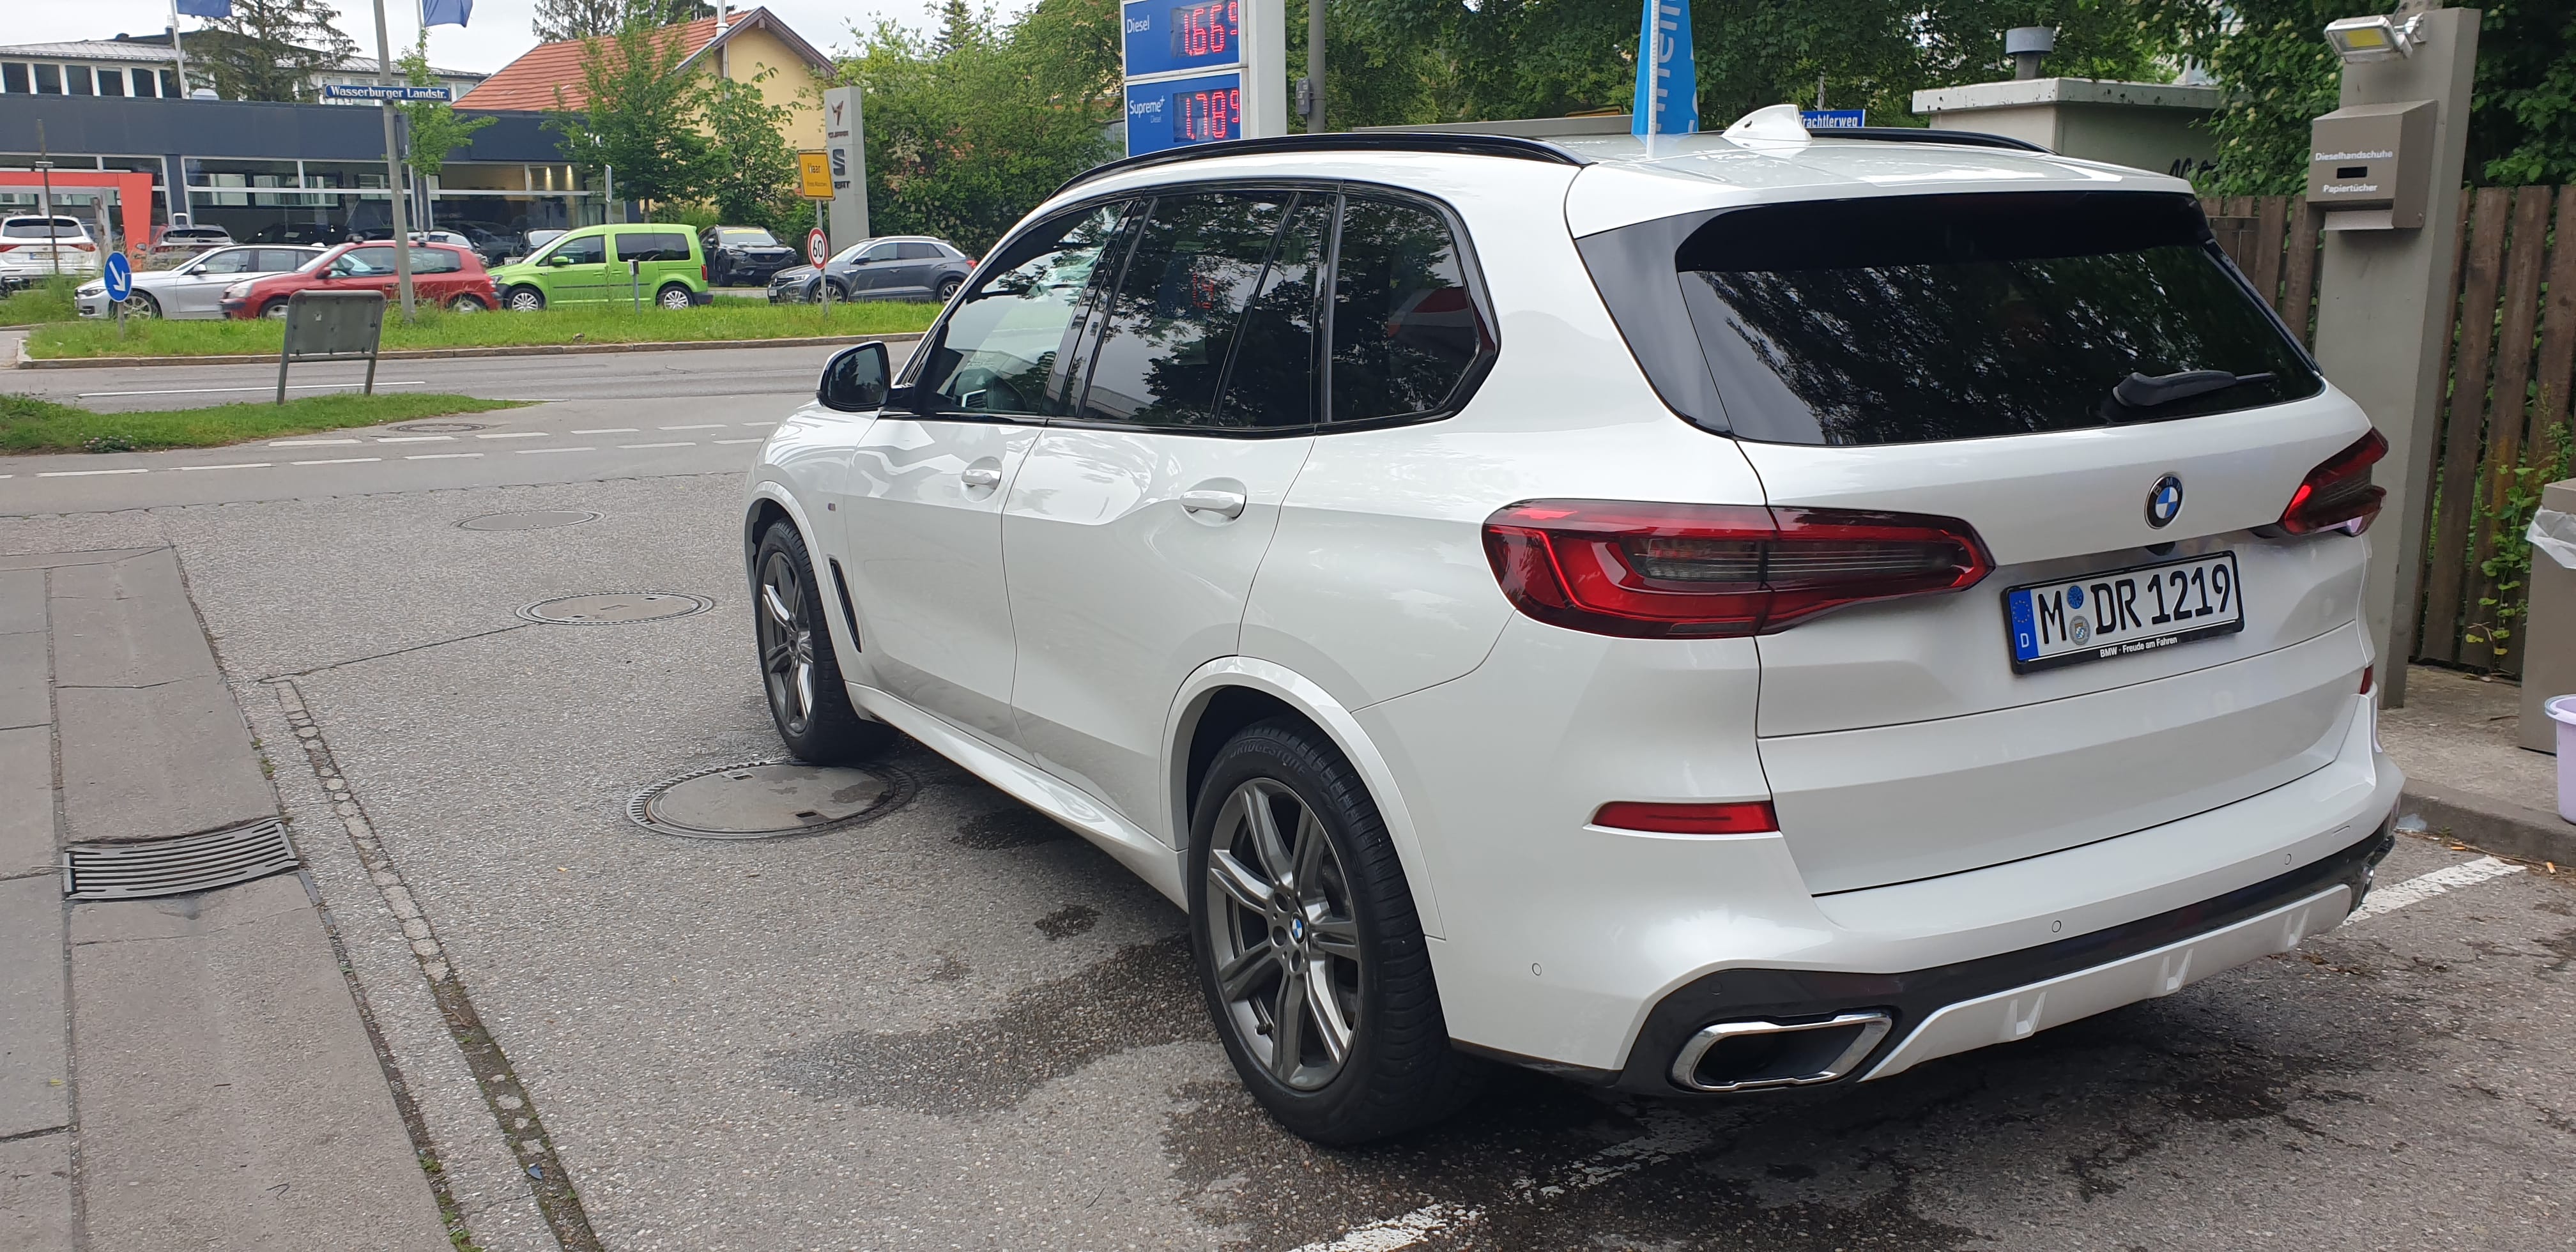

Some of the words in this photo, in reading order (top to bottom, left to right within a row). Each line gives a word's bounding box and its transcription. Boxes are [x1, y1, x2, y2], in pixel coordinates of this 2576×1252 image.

[1126, 15, 1150, 34] Diesel
[331, 85, 403, 99] Wasserburger
[406, 88, 447, 99] Landstr.
[2315, 149, 2393, 162] Dieselhandschuhe
[2322, 183, 2378, 194] Papiertücher
[813, 240, 824, 258] 60
[2037, 590, 2067, 645] M
[2090, 578, 2142, 636] DR
[2147, 563, 2232, 626] 1219
[2099, 646, 2118, 658] BMW
[2122, 642, 2145, 653] Freude
[2145, 641, 2156, 650] am
[2156, 637, 2178, 647] Fahren
